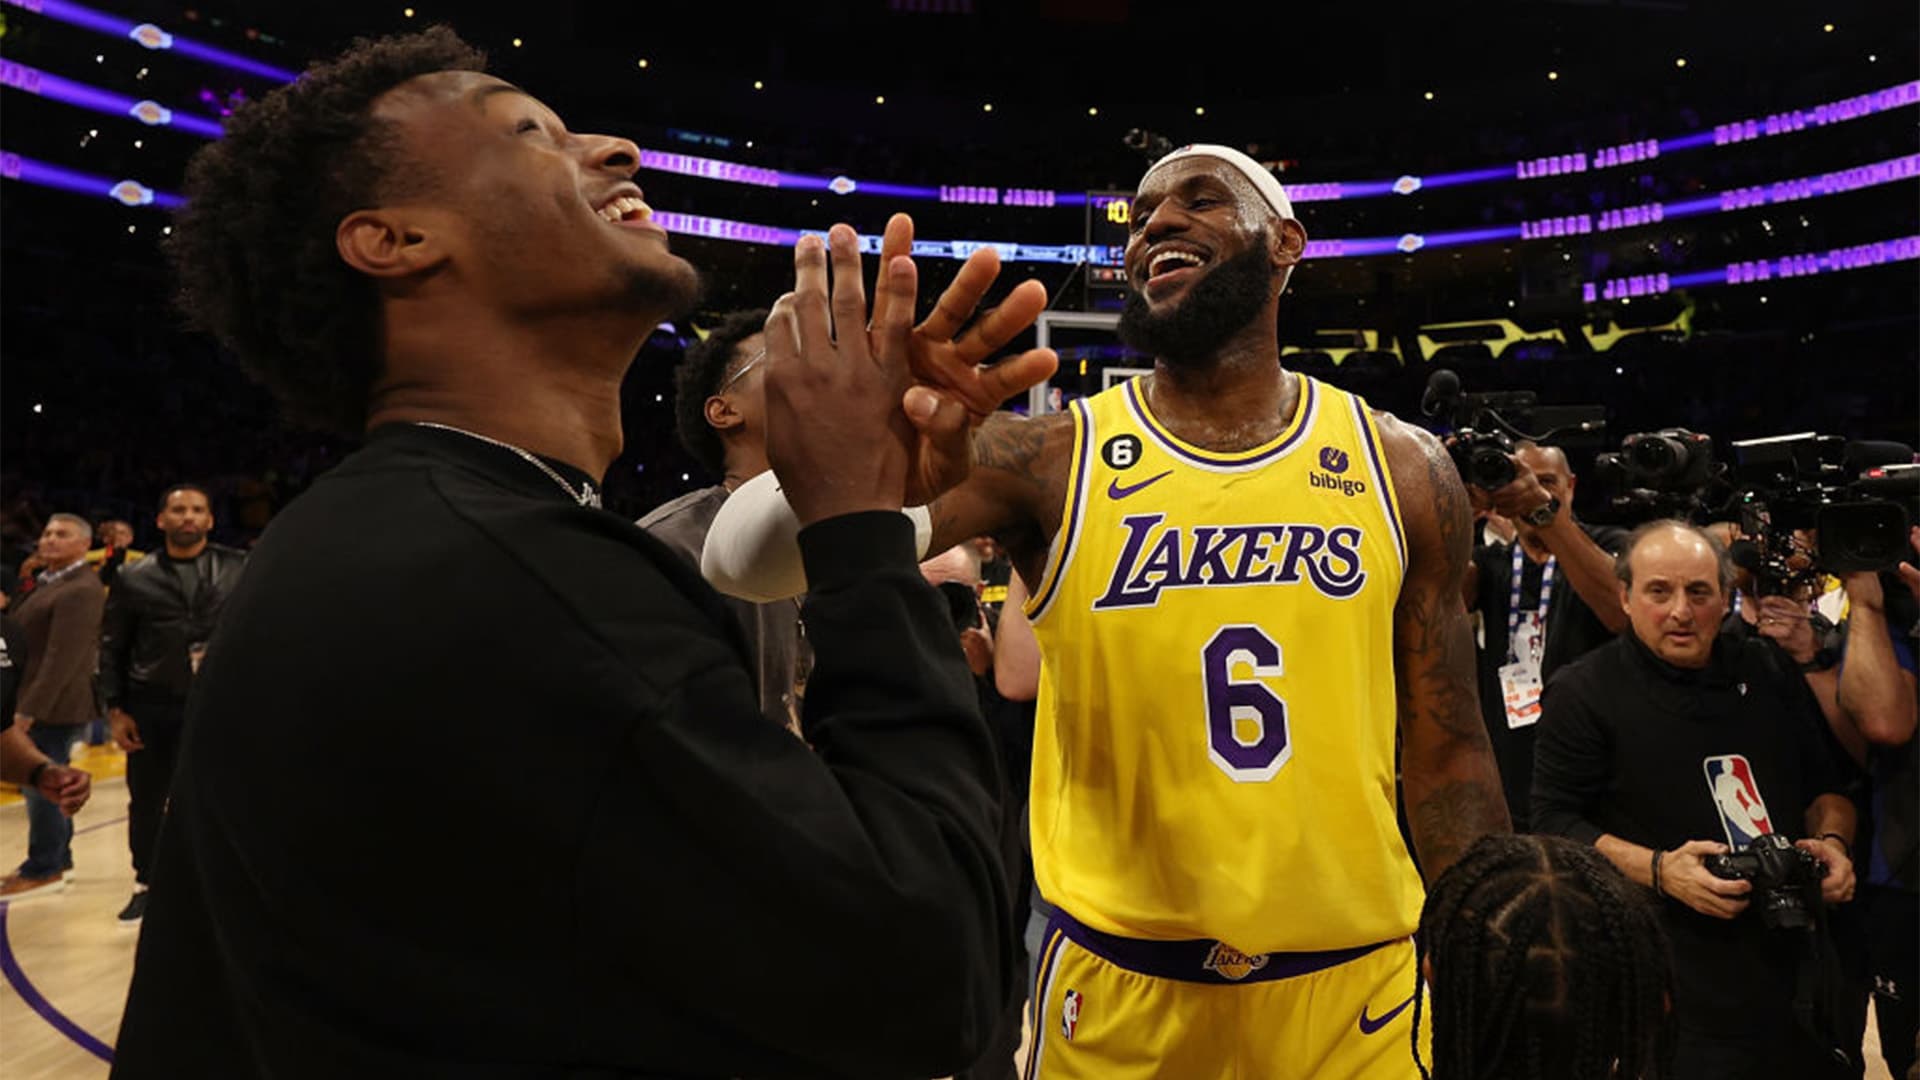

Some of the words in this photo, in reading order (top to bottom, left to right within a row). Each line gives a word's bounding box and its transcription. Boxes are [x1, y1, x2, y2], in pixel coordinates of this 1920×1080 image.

[1111, 439, 1134, 465] 6
[1309, 471, 1366, 496] bibigo
[1091, 512, 1367, 611] LAKERS
[1200, 623, 1293, 783] 6
